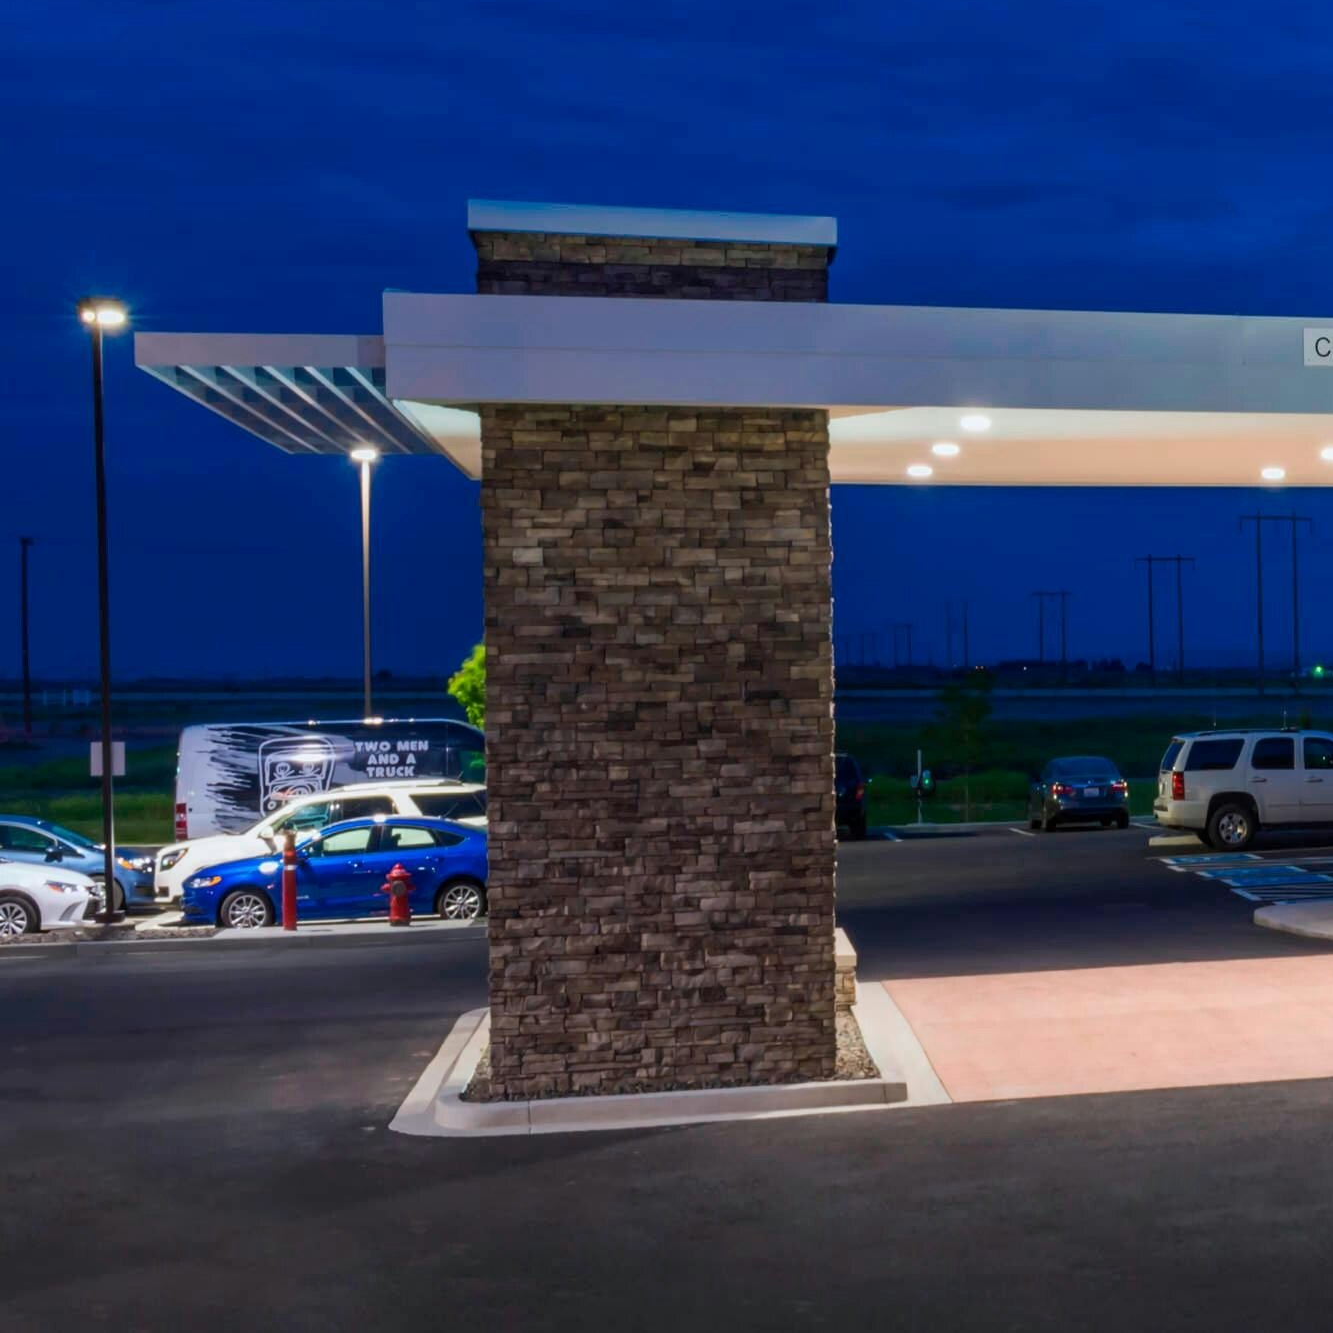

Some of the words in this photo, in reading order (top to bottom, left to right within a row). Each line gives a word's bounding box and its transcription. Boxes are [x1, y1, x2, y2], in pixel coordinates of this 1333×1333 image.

[355, 741, 391, 752] TWO
[396, 740, 429, 752] MEN
[367, 753, 399, 765] AND
[405, 753, 417, 764] A
[366, 766, 415, 778] TRUCK
